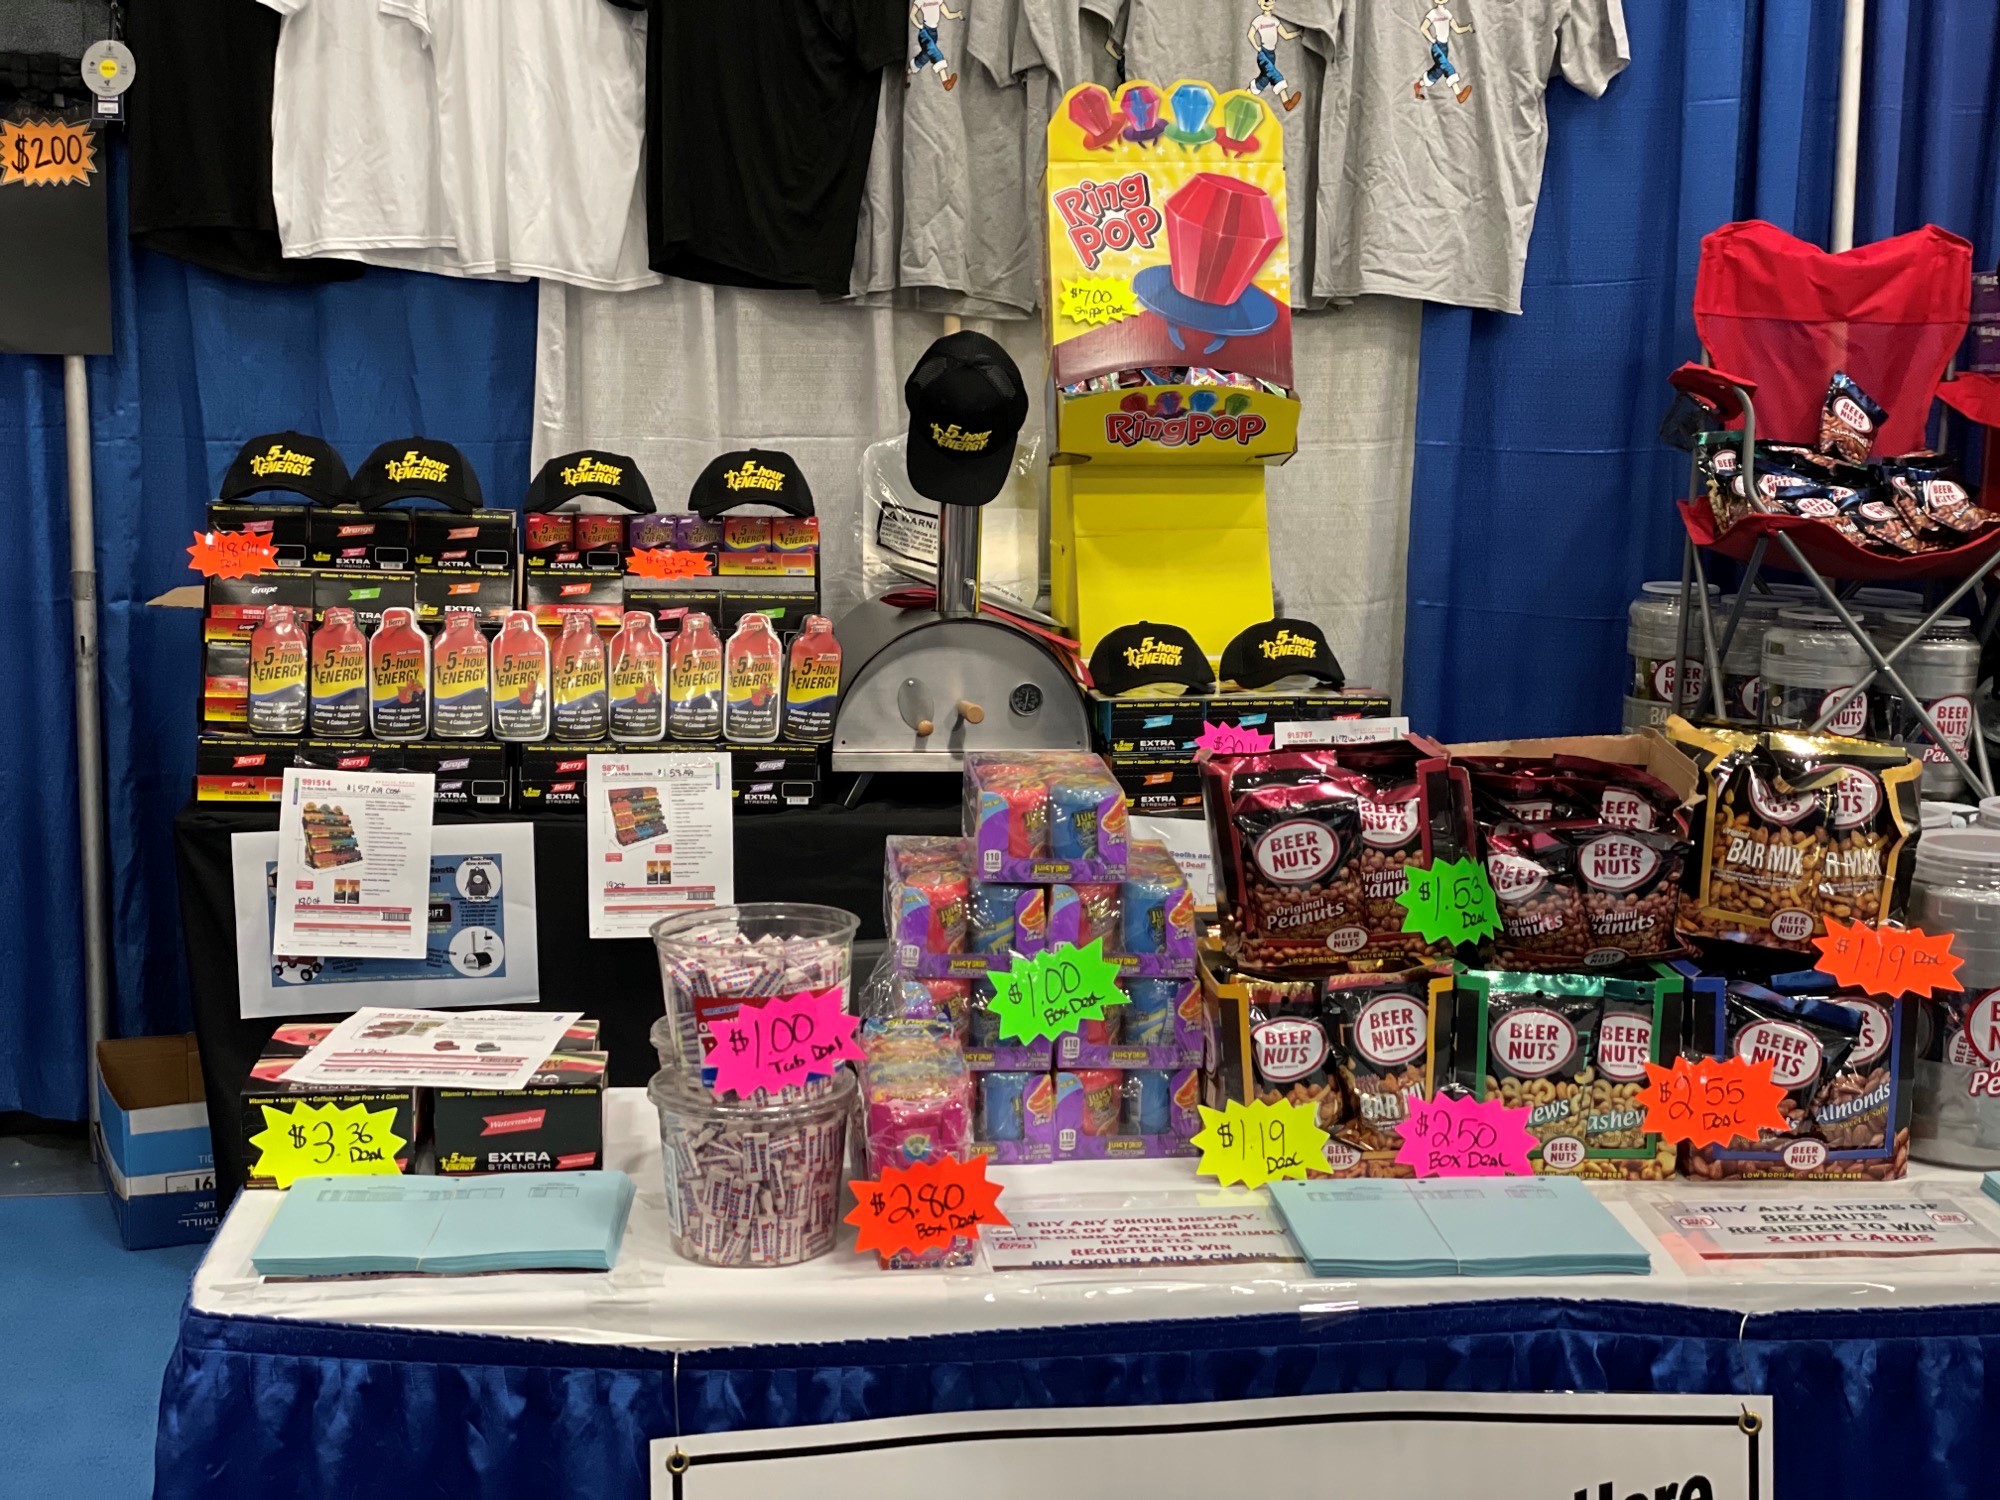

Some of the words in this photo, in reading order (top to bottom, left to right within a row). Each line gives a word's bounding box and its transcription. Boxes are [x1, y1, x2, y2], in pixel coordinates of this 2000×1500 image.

[11, 134, 82, 174] $200
[1054, 172, 1149, 227] Ring
[1840, 410, 1863, 428] NUTS
[1843, 402, 1865, 420] BEER
[268, 445, 315, 466] 5-hour
[402, 451, 450, 472] 5-hour
[261, 461, 311, 476] ENERGY
[578, 457, 622, 476] 5-hour
[740, 461, 785, 481] 5-hour
[397, 467, 447, 483] ENERGY
[573, 471, 620, 486] ENERGY
[735, 475, 783, 491] ENERGY
[251, 586, 278, 595] Grape
[444, 605, 482, 613] EXTRA
[1140, 637, 1183, 656] 5-hour
[1276, 630, 1316, 648] 5-hour
[1136, 651, 1182, 667] ENERGY
[1271, 644, 1316, 659] ENERGY
[259, 663, 304, 681] ENERGY
[320, 667, 364, 684] ENERGY
[377, 669, 420, 686] ENERGY
[441, 668, 486, 685] ENERGY
[796, 675, 838, 690] ENERGY
[1937, 706, 1968, 719] BEER
[1936, 720, 1968, 736] NUTS
[238, 756, 263, 767] Berry
[342, 757, 367, 767] Berry
[561, 761, 584, 771] Berry
[758, 760, 784, 772] Grape
[545, 793, 580, 801] EXTRA
[744, 793, 778, 801] EXTRA
[1270, 831, 1318, 852] BEER
[985, 852, 1000, 861] 110
[1593, 843, 1643, 859] BEER
[1726, 838, 1765, 870] BAR
[1272, 847, 1322, 873] NUTS
[1593, 857, 1642, 877] NUTS
[1276, 897, 1325, 917] Original
[1267, 902, 1346, 930] Peanuts
[1779, 914, 1807, 926] BEER
[1334, 932, 1361, 942] BEER
[1778, 925, 1807, 936] NUTS
[1333, 940, 1361, 949] NUTS
[1008, 961, 1081, 1018] $1.00
[1370, 1008, 1415, 1029] BEER
[1264, 1029, 1311, 1046] BEER
[1371, 1027, 1417, 1052] NUTS
[1510, 1023, 1560, 1041] BEER
[1602, 1025, 1651, 1044] BEER
[1064, 1039, 1079, 1049] 110
[1508, 1041, 1559, 1061] NUTS
[1756, 1029, 1808, 1057] BEER
[1263, 1046, 1310, 1067] NUTS
[1602, 1045, 1650, 1065] NUTS
[1750, 1045, 1802, 1077] NUTS
[312, 1094, 338, 1102] Caffeine
[343, 1095, 360, 1103] Sugar
[386, 1092, 409, 1100] Calories
[1816, 1081, 1891, 1122] Almonds
[488, 1115, 543, 1130] Watermelon
[1061, 1131, 1074, 1140] 110
[1551, 1142, 1579, 1153] BEER
[1792, 1145, 1820, 1155] BEER
[450, 1152, 478, 1165] 5-hour
[487, 1152, 551, 1163] EXTRA
[1429, 1150, 1461, 1169] Box
[1550, 1152, 1578, 1163] NUTS
[1790, 1154, 1819, 1165] NUTS
[446, 1160, 477, 1172] ENERGY
[487, 1163, 552, 1171] STRENGTH
[1742, 1172, 1760, 1180] LOW
[1808, 1172, 1839, 1180] GLUTEN
[1842, 1172, 1863, 1180] FREE
[870, 1183, 965, 1224] $2.80
[1700, 1205, 1748, 1213] BUY
[1834, 1203, 1906, 1212] ITEMS
[1027, 1220, 1064, 1229] BUY
[1070, 1219, 1108, 1227] ANY
[1760, 1212, 1888, 1222] BEERNUTS
[915, 1223, 947, 1240] Box
[1039, 1228, 1079, 1236] BOX
[1083, 1226, 1108, 1235] OF
[1109, 1222, 1239, 1234] WATERMELON
[1218, 1228, 1289, 1237] GUMMY
[1727, 1223, 1847, 1234] REGISTER
[1851, 1222, 1886, 1232] TO
[1895, 1222, 1938, 1232] WIN
[1101, 1238, 1132, 1246] DIP
[1152, 1237, 1195, 1245] STIX
[1766, 1235, 1784, 1244] 2
[1787, 1233, 1843, 1243] GIFT
[1849, 1232, 1937, 1243] CARDS
[1071, 1246, 1162, 1257] REGISTER
[1167, 1244, 1194, 1253] TO
[1198, 1243, 1233, 1252] WIN
[1068, 1257, 1141, 1267] COOLER
[1150, 1254, 1190, 1264] AND
[1207, 1251, 1280, 1261] CHAIRS
